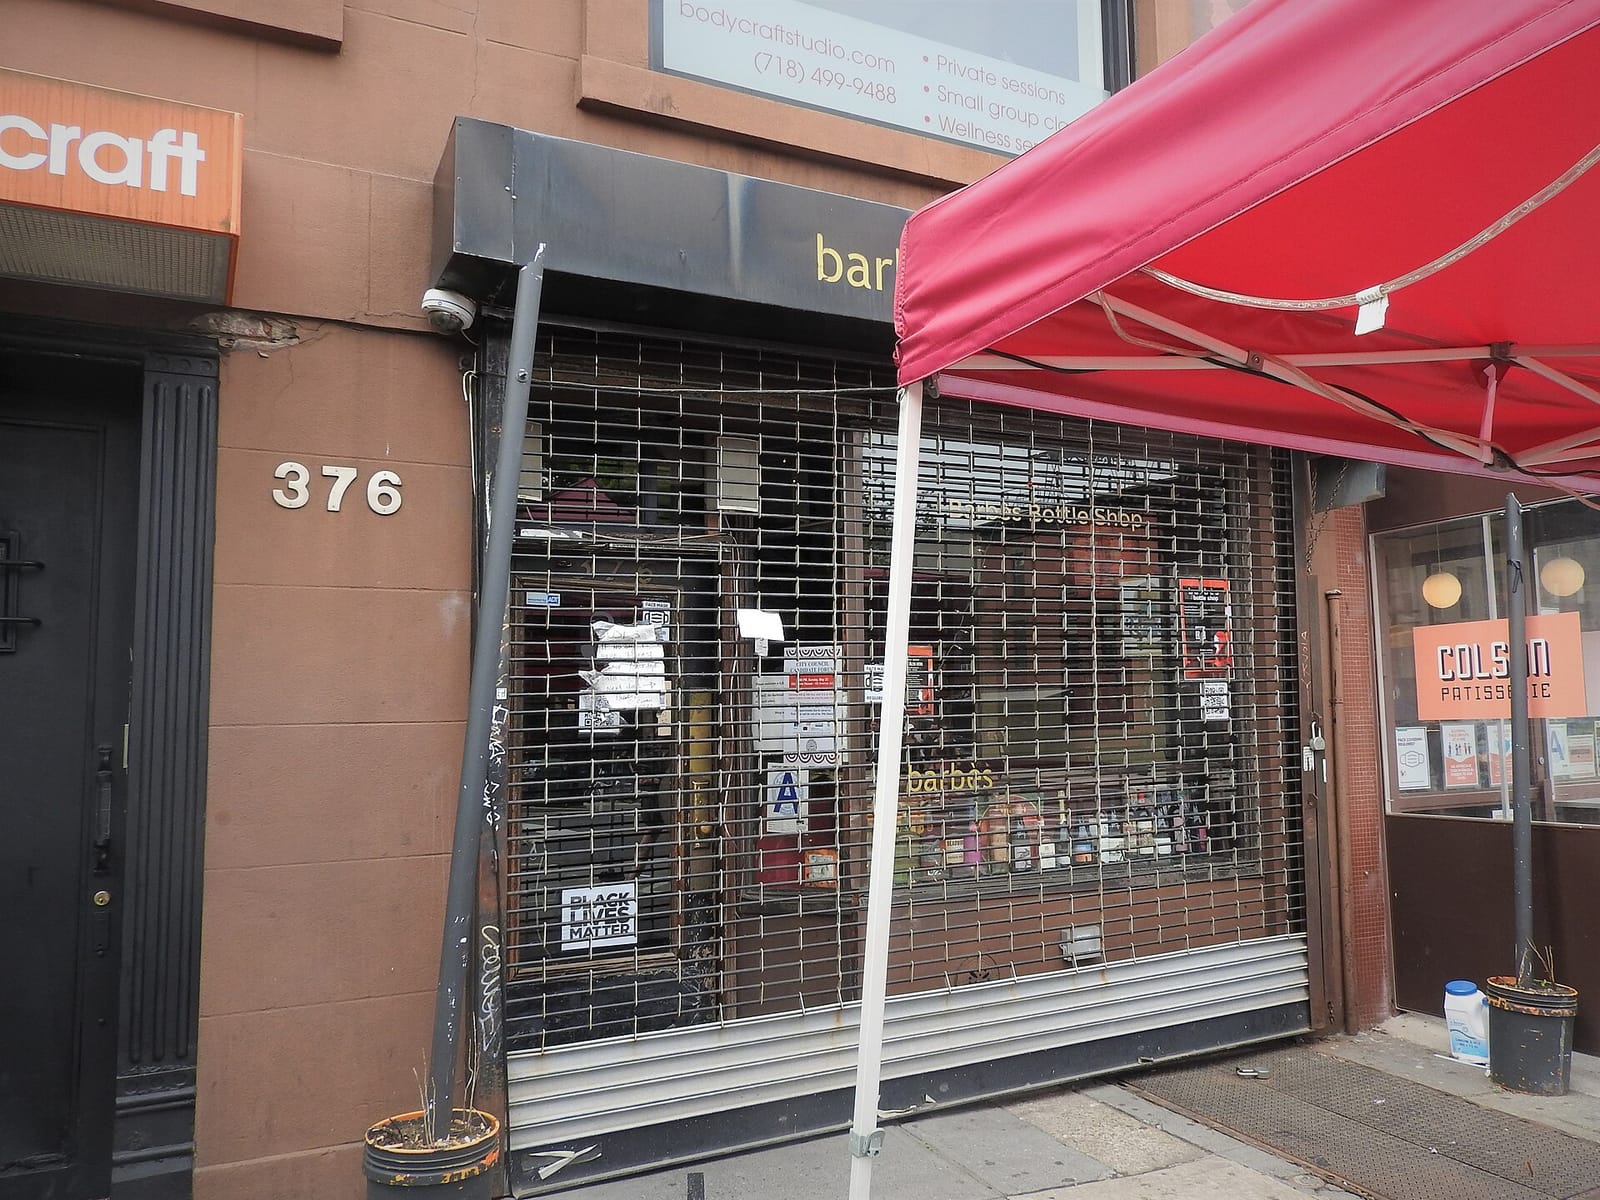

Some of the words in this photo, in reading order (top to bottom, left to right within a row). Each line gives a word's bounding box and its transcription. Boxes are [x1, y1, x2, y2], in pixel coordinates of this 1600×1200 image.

[680, 0, 896, 73] bodycraftstudio.com
[754, 51, 805, 84] (718)
[811, 67, 897, 104] 499-9488
[937, 54, 997, 86] Private
[1002, 75, 1066, 106] sessions
[937, 84, 984, 111] Small
[988, 102, 1040, 129] group
[938, 114, 1012, 149] Wellness
[1015, 136, 1036, 151] se
[0, 114, 206, 197] craft
[816, 232, 900, 291] bar
[272, 461, 403, 515] 376
[1028, 503, 1089, 525] Bottle
[1094, 508, 1143, 532] Shop
[1437, 638, 1551, 681] COLSN
[1441, 682, 1551, 702] PATISSIE
[773, 772, 800, 815] A
[908, 761, 993, 791] barbès
[570, 892, 630, 910] BLACK
[570, 906, 630, 927] LIVES
[569, 924, 630, 940] MATTER
